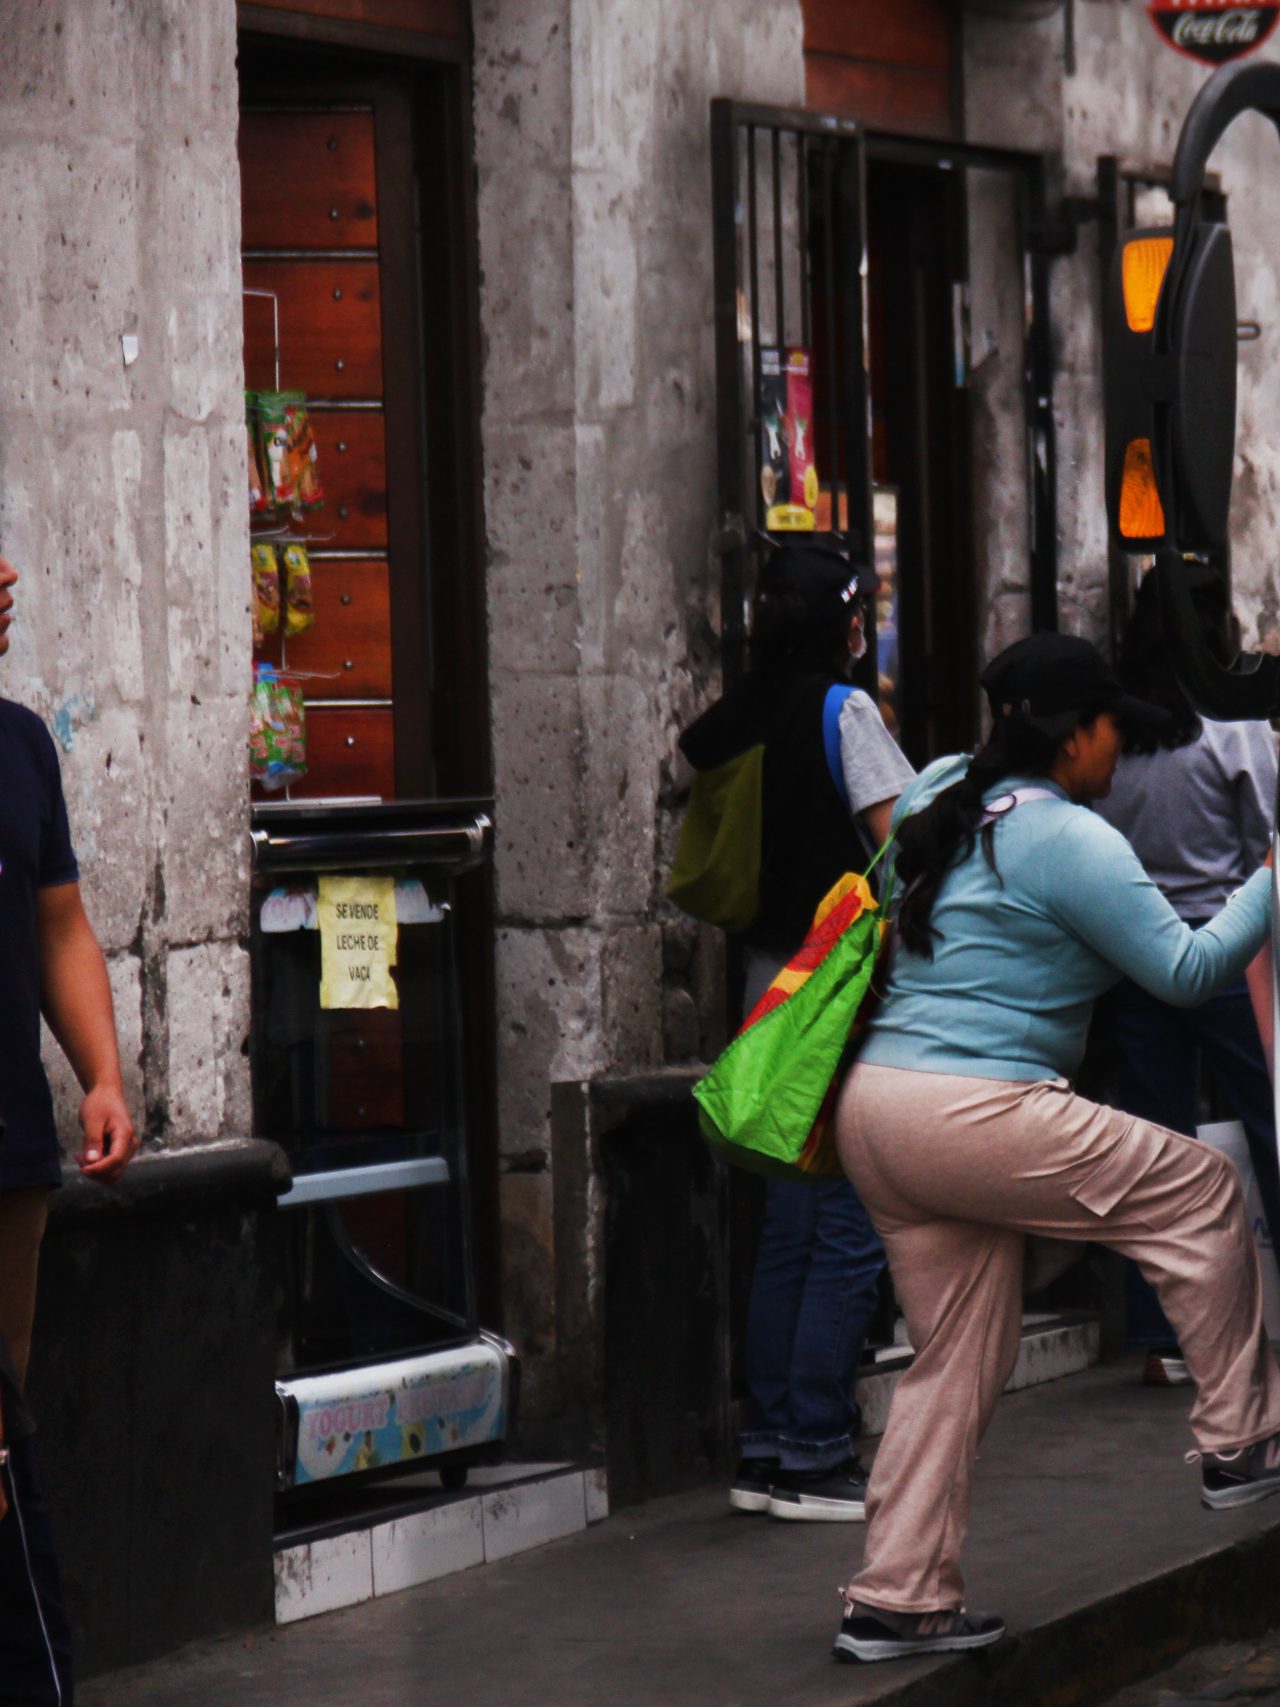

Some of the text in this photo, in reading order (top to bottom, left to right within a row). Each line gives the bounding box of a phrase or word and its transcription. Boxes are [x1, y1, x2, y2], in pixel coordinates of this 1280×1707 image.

[335, 903, 379, 920] SE VENDE
[337, 935, 379, 951] LECHE DE
[348, 966, 371, 981] VACA
